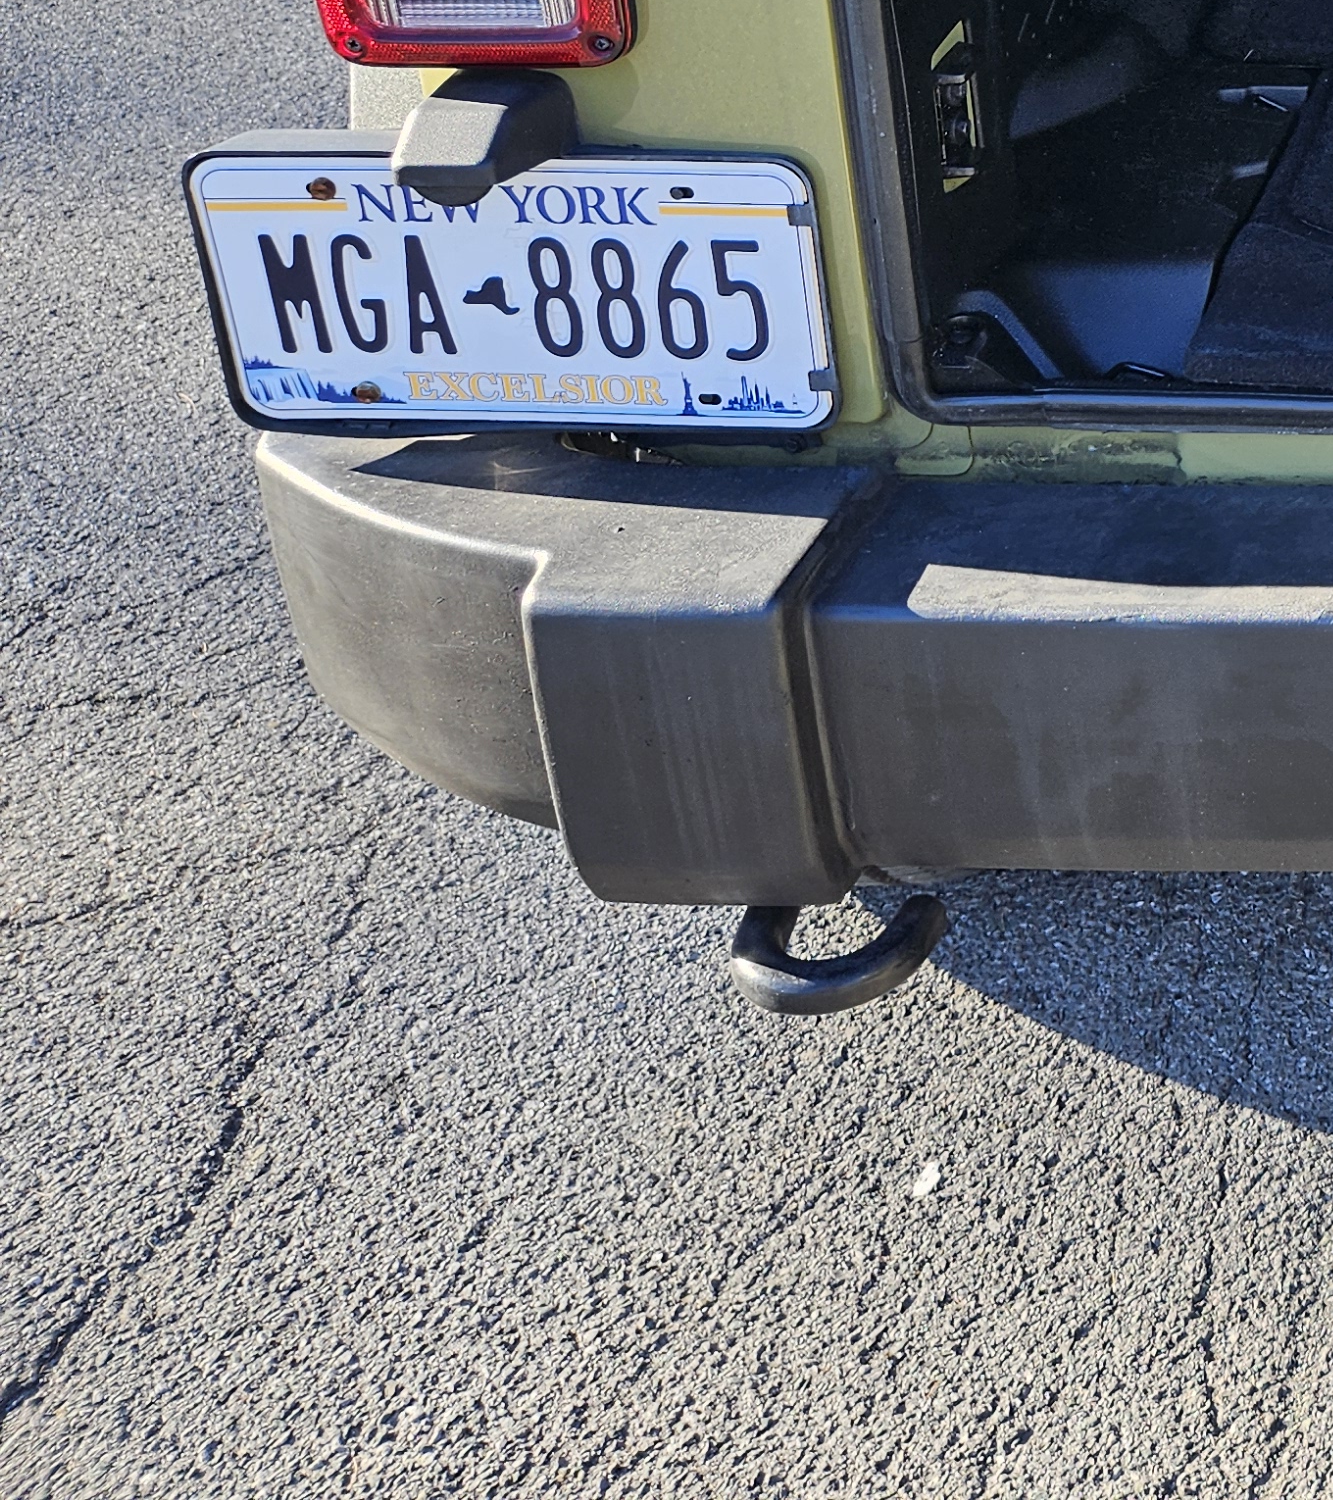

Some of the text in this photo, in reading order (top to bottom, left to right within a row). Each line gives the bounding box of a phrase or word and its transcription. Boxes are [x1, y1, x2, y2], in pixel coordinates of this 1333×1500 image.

[498, 184, 658, 226] YORK
[258, 233, 769, 362] MGA 8865
[402, 369, 669, 407] EXCELSIOR
